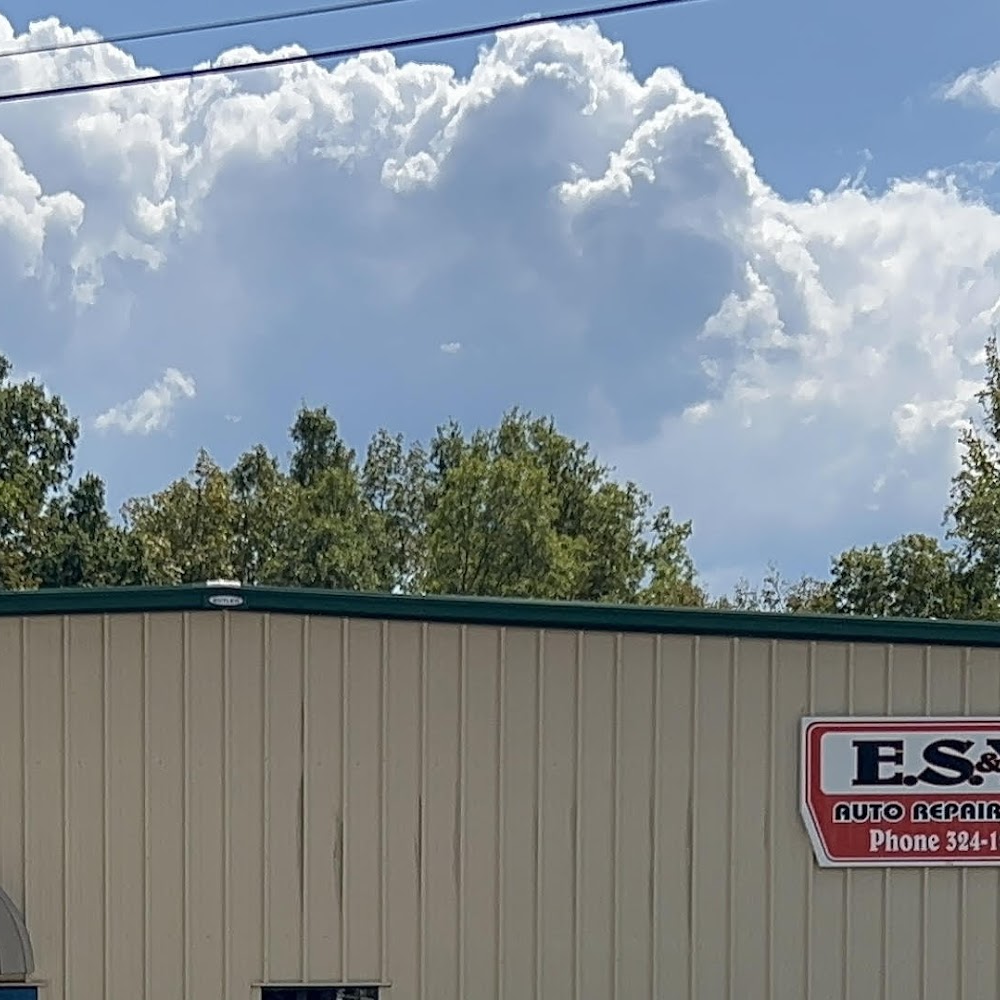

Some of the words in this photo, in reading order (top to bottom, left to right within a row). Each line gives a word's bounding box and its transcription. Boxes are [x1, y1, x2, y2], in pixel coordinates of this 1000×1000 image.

[833, 802, 904, 822] AUTO
[911, 801, 1000, 822] REPAIR
[869, 829, 940, 852] Phone
[945, 830, 1000, 852] 324-1
